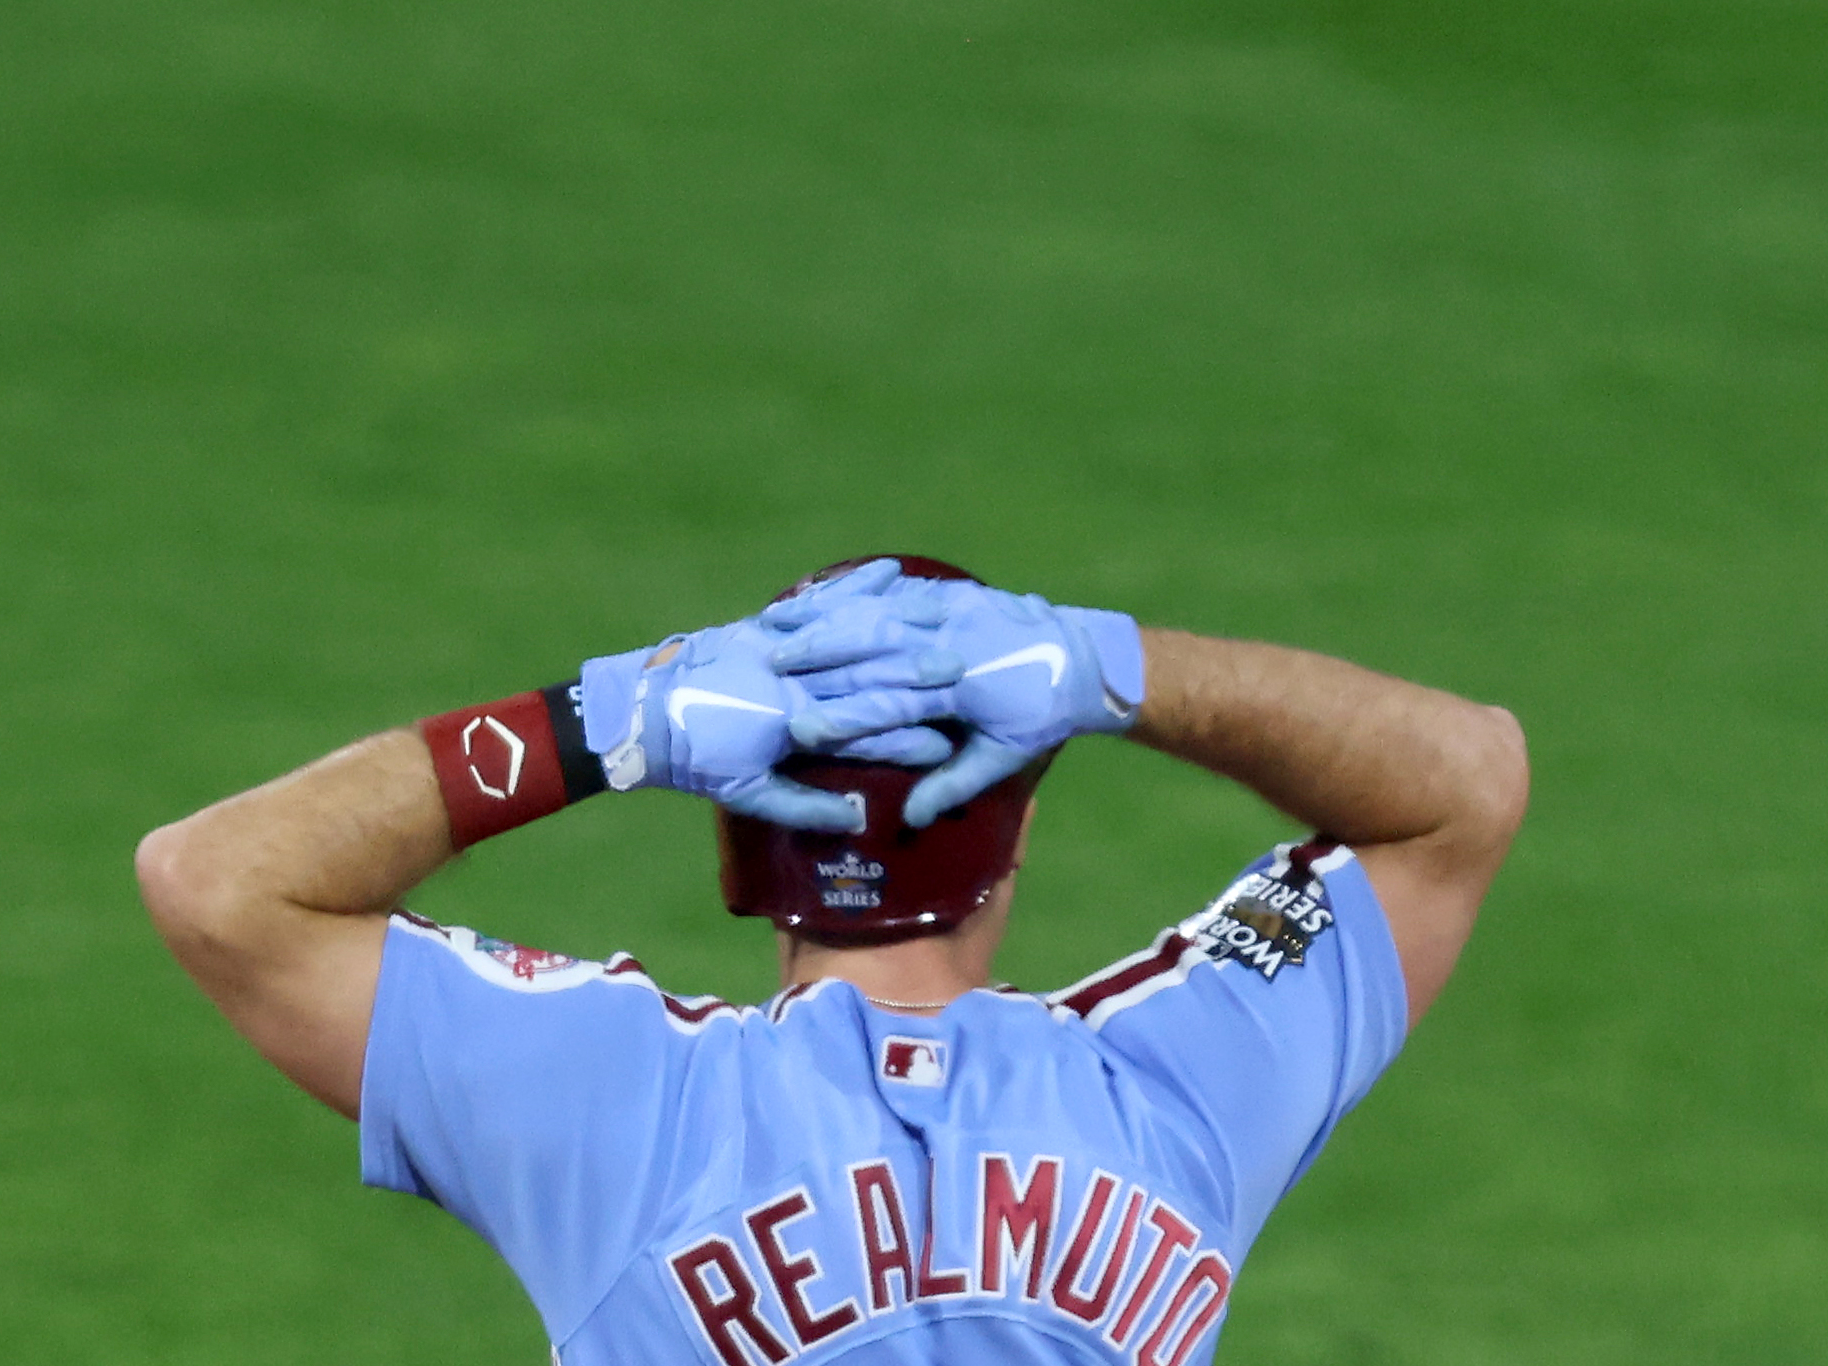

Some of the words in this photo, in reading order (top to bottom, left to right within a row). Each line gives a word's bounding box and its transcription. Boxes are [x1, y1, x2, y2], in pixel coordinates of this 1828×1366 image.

[816, 861, 885, 879] WORLD
[822, 890, 882, 907] SERIES
[1238, 873, 1334, 932] SERIE
